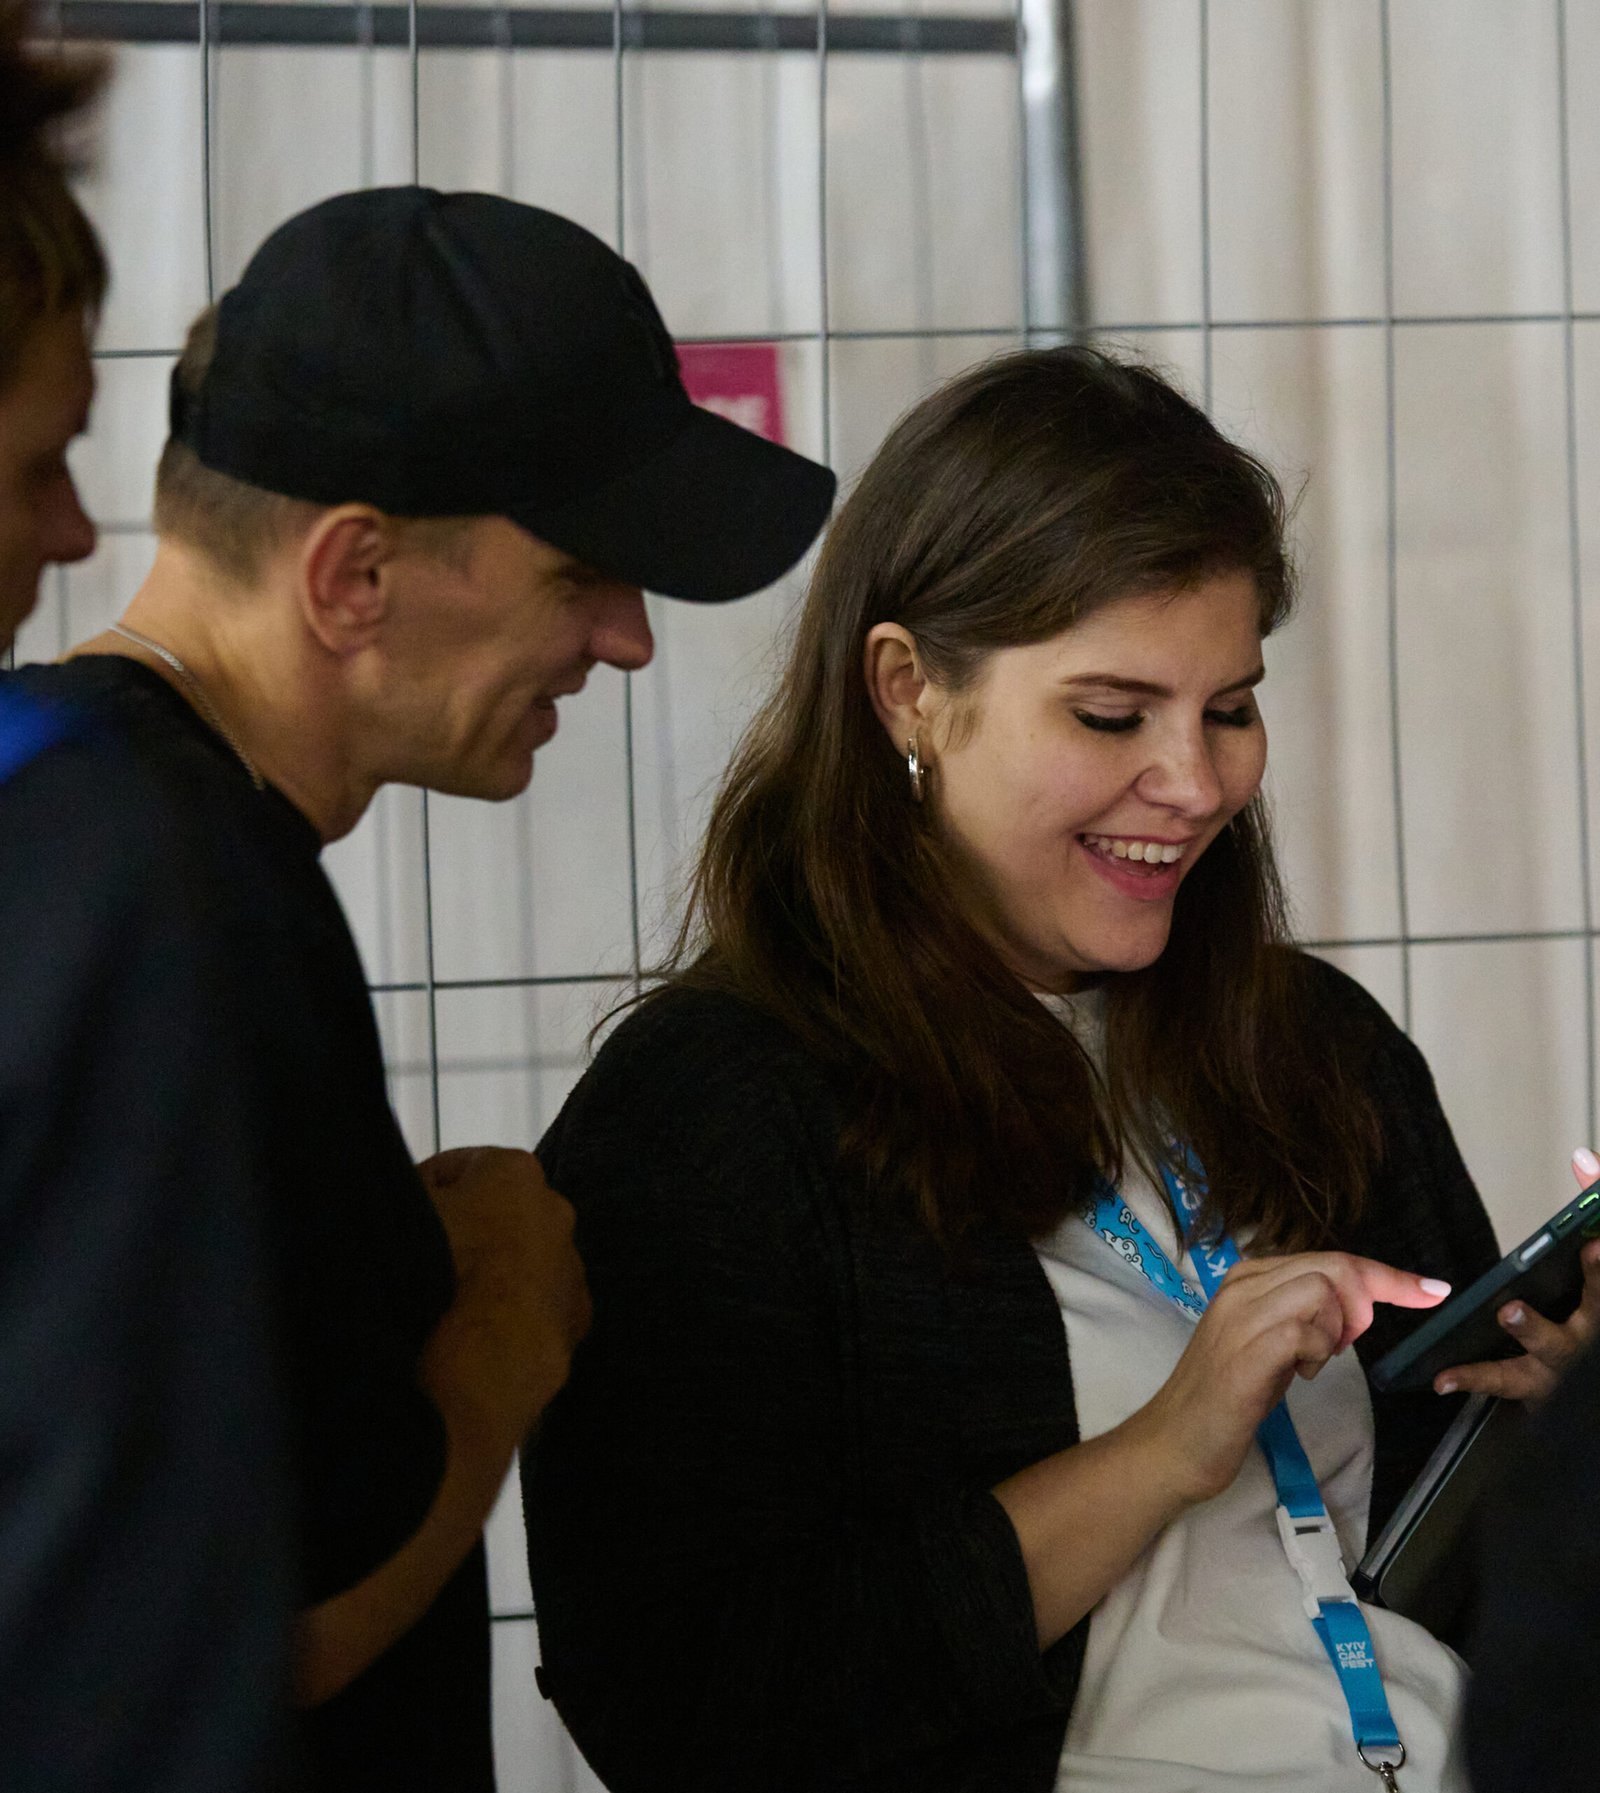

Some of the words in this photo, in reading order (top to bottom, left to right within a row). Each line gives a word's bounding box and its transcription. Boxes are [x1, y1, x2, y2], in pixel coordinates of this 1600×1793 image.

[1335, 1641, 1366, 1652] KYIV
[1338, 1651, 1366, 1660] CAR
[1341, 1658, 1374, 1669] FEST
